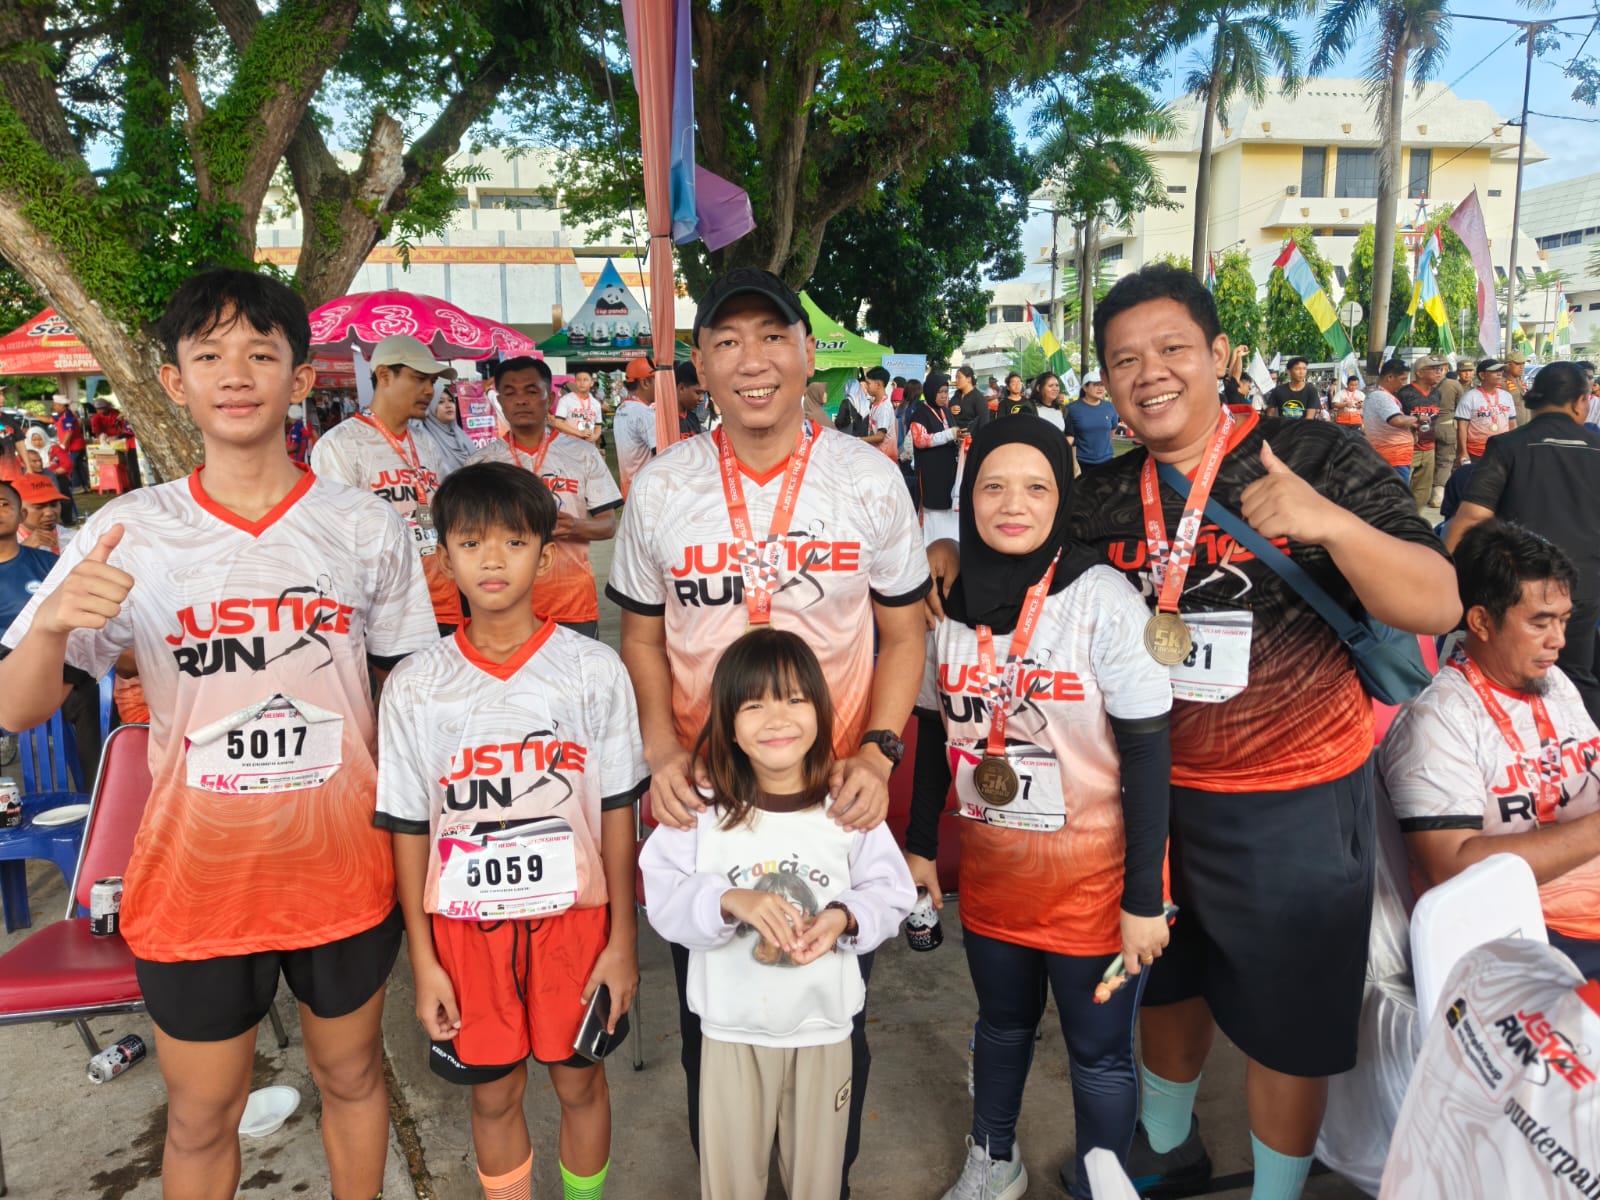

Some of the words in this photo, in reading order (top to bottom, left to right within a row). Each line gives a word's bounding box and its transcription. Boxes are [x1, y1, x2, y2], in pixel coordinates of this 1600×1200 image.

[165, 597, 355, 646] JUSTICE
[173, 636, 266, 677] RUN
[227, 726, 306, 759] 5017
[466, 854, 543, 887] 5059
[727, 853, 830, 887] Francisco
[447, 900, 475, 916] 5K
